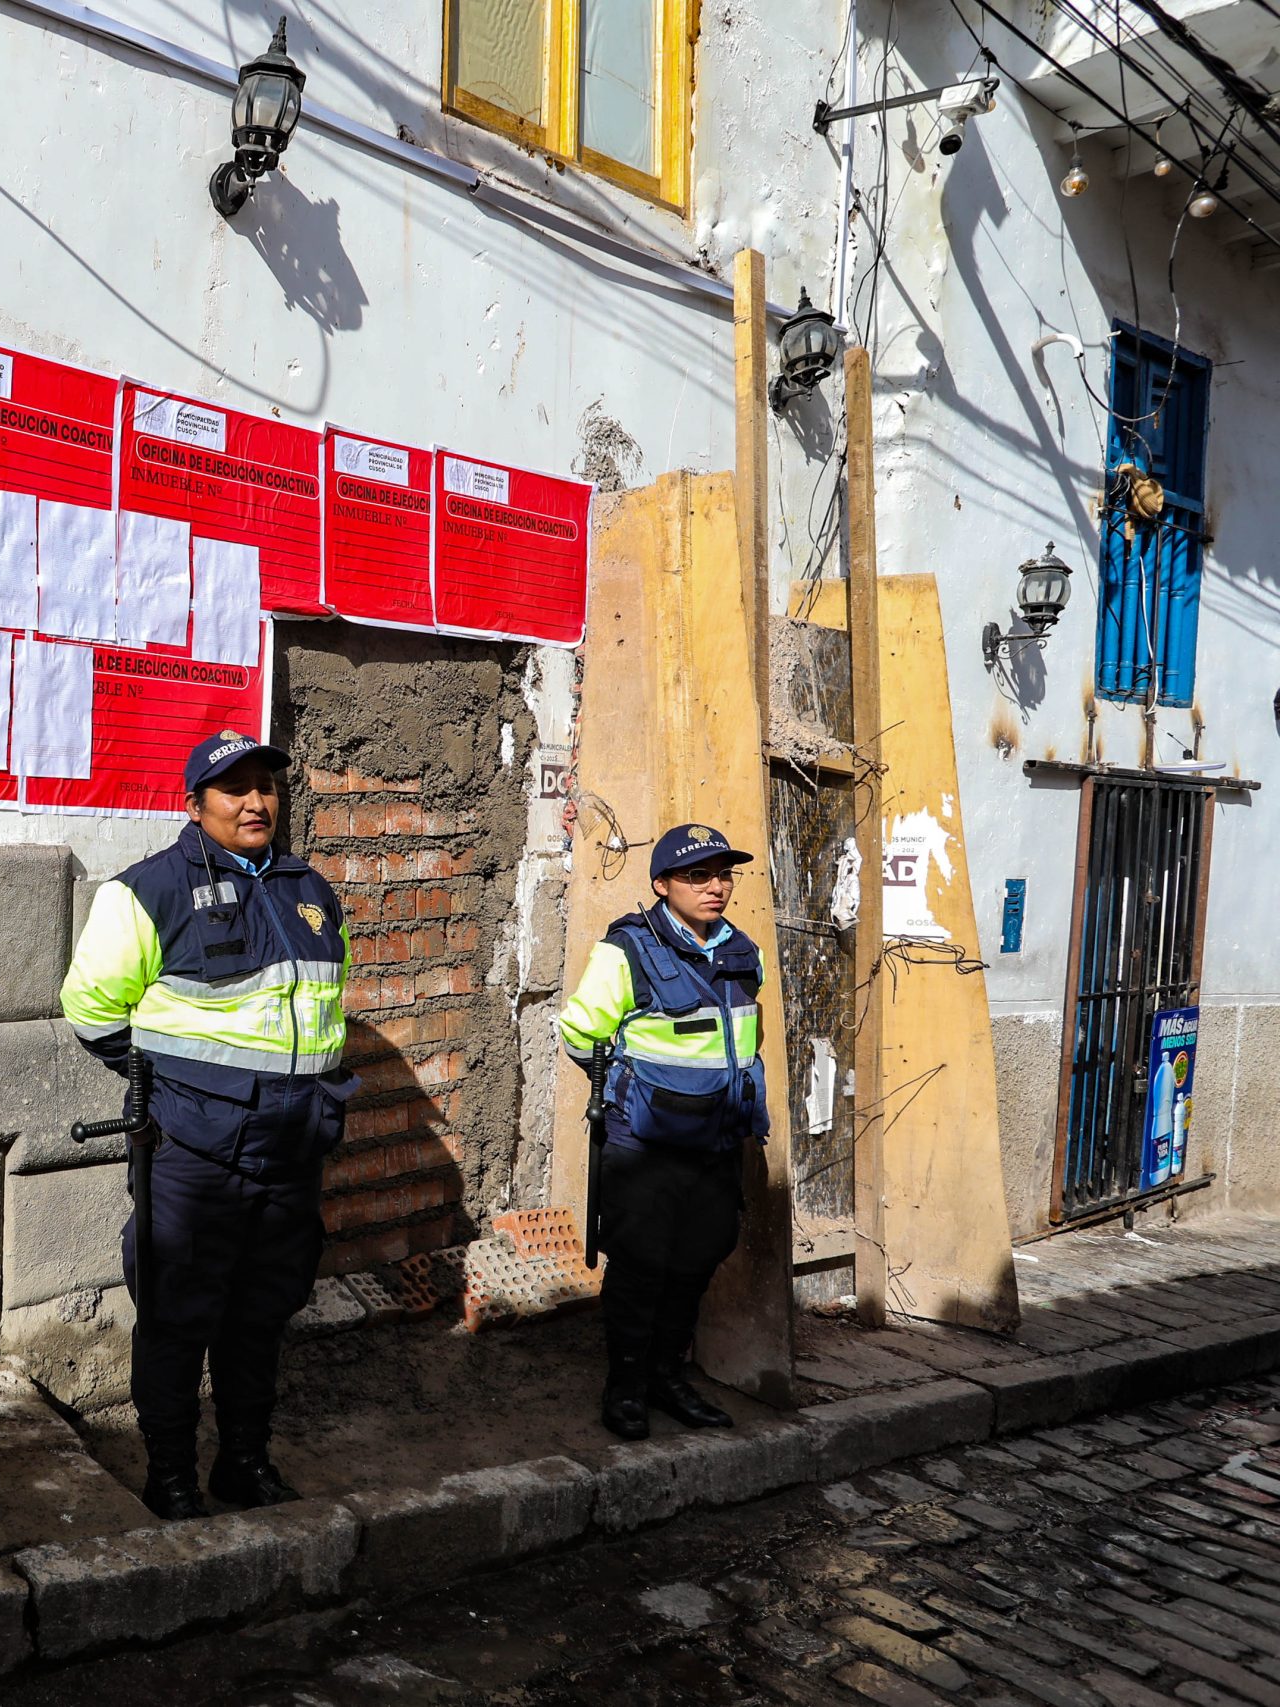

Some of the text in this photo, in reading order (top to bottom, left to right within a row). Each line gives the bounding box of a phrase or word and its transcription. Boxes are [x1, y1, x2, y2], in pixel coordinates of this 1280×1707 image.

[176, 426, 198, 436] CUSCO
[130, 466, 204, 495] INMUEBLE
[141, 443, 315, 496] OFICINA DE EJECUCIÓN COACTIVA
[341, 481, 377, 500] OFICINA
[380, 490, 391, 504] DE
[333, 503, 392, 526] INMUEBLE
[450, 500, 575, 538] OFICINA DE EJECUCIÓN COACTIVA
[443, 521, 495, 541] INMUEBLE
[108, 655, 123, 672] DE
[125, 658, 188, 681] EJECUCIÓN
[191, 665, 244, 687] COACTIVA
